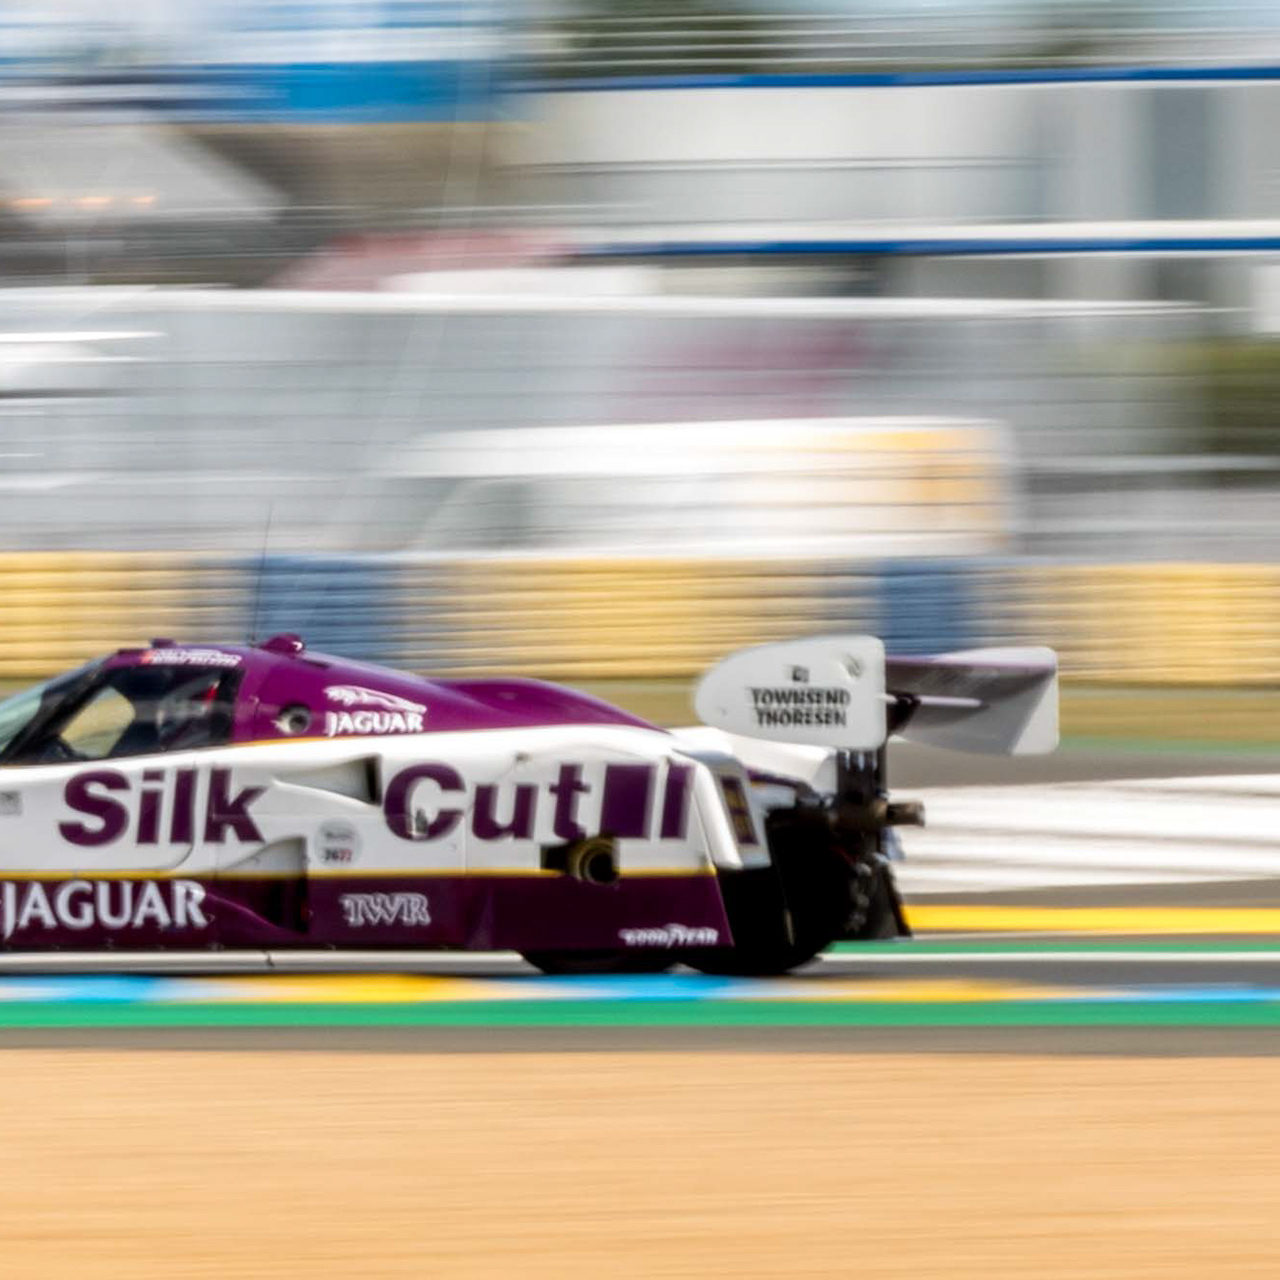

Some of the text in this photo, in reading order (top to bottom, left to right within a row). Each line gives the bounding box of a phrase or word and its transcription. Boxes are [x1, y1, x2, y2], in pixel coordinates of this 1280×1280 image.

[747, 686, 851, 705] TOWNSEND
[324, 710, 424, 737] JAGUAR
[754, 706, 848, 726] THORESEN
[58, 760, 590, 847] Silk Cut
[0, 881, 208, 936] JAGUAR
[340, 893, 431, 926] TWR
